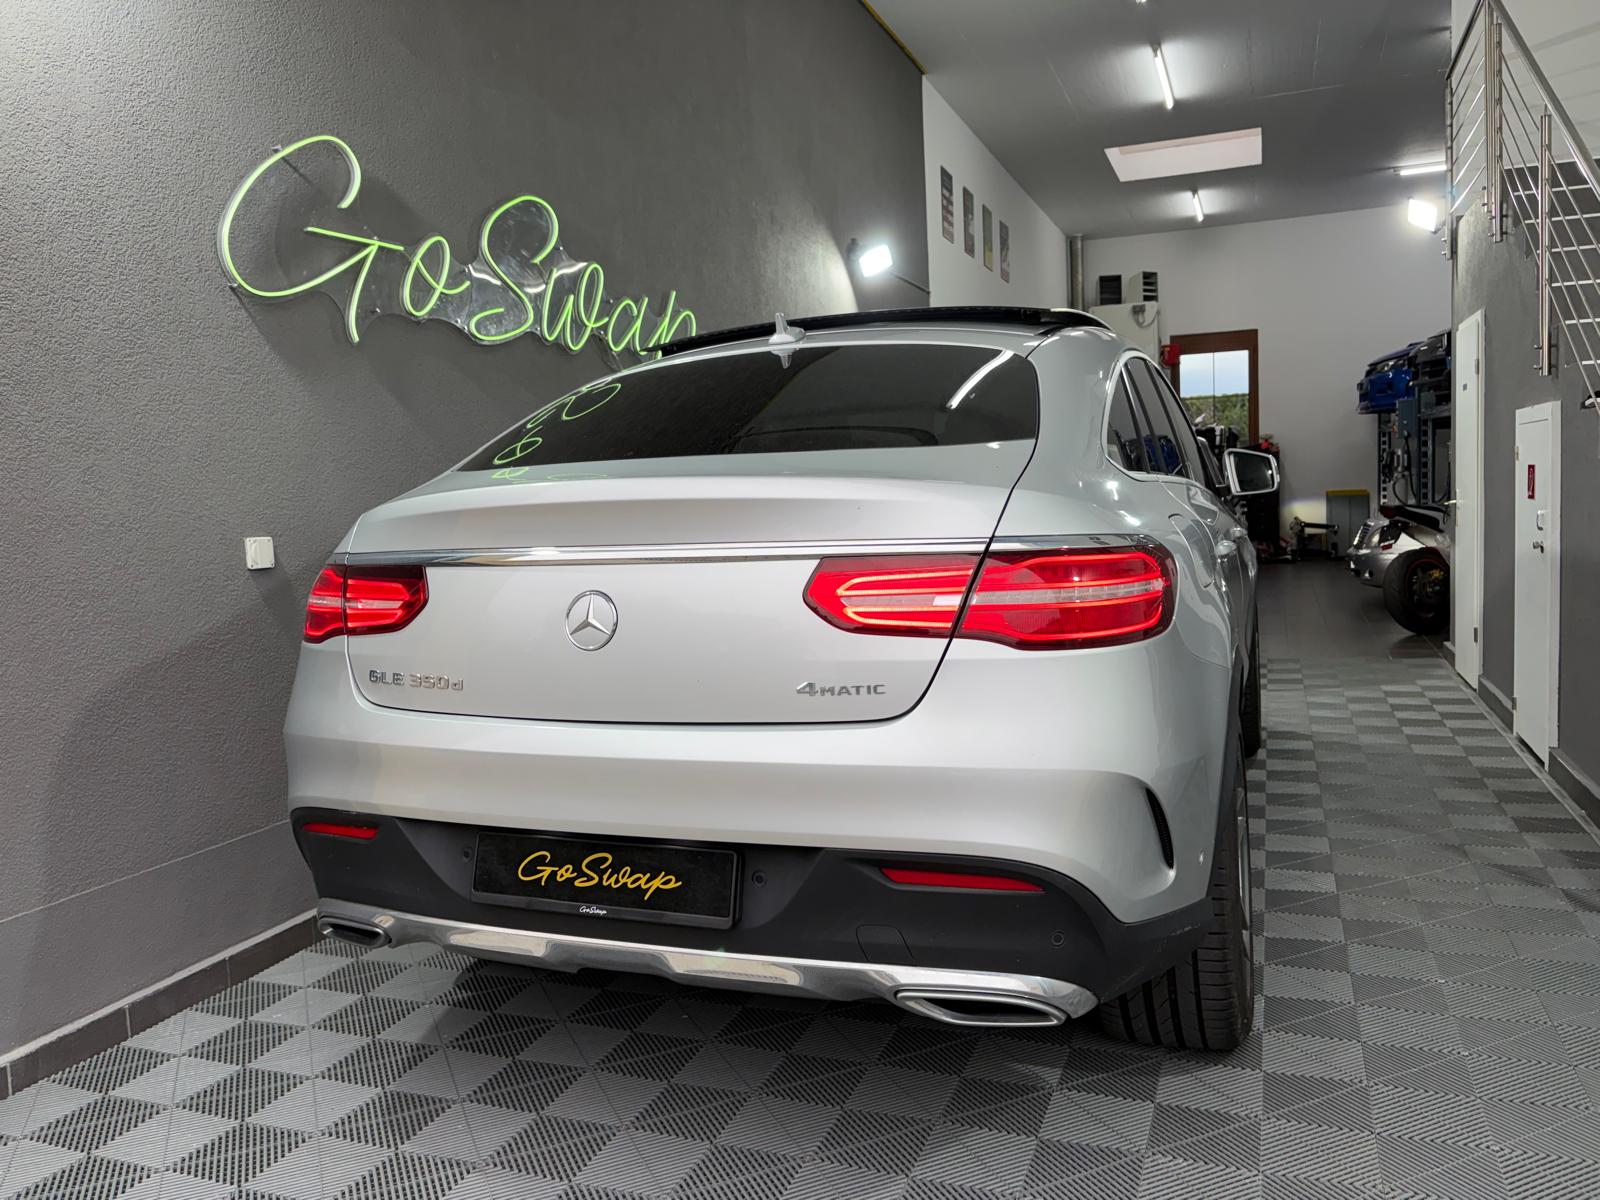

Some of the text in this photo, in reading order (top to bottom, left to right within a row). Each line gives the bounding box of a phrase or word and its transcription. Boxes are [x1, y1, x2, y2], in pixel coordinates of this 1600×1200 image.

[368, 669, 405, 687] GLE
[796, 681, 887, 697] 4MATIC
[517, 850, 682, 901] GoSwap
